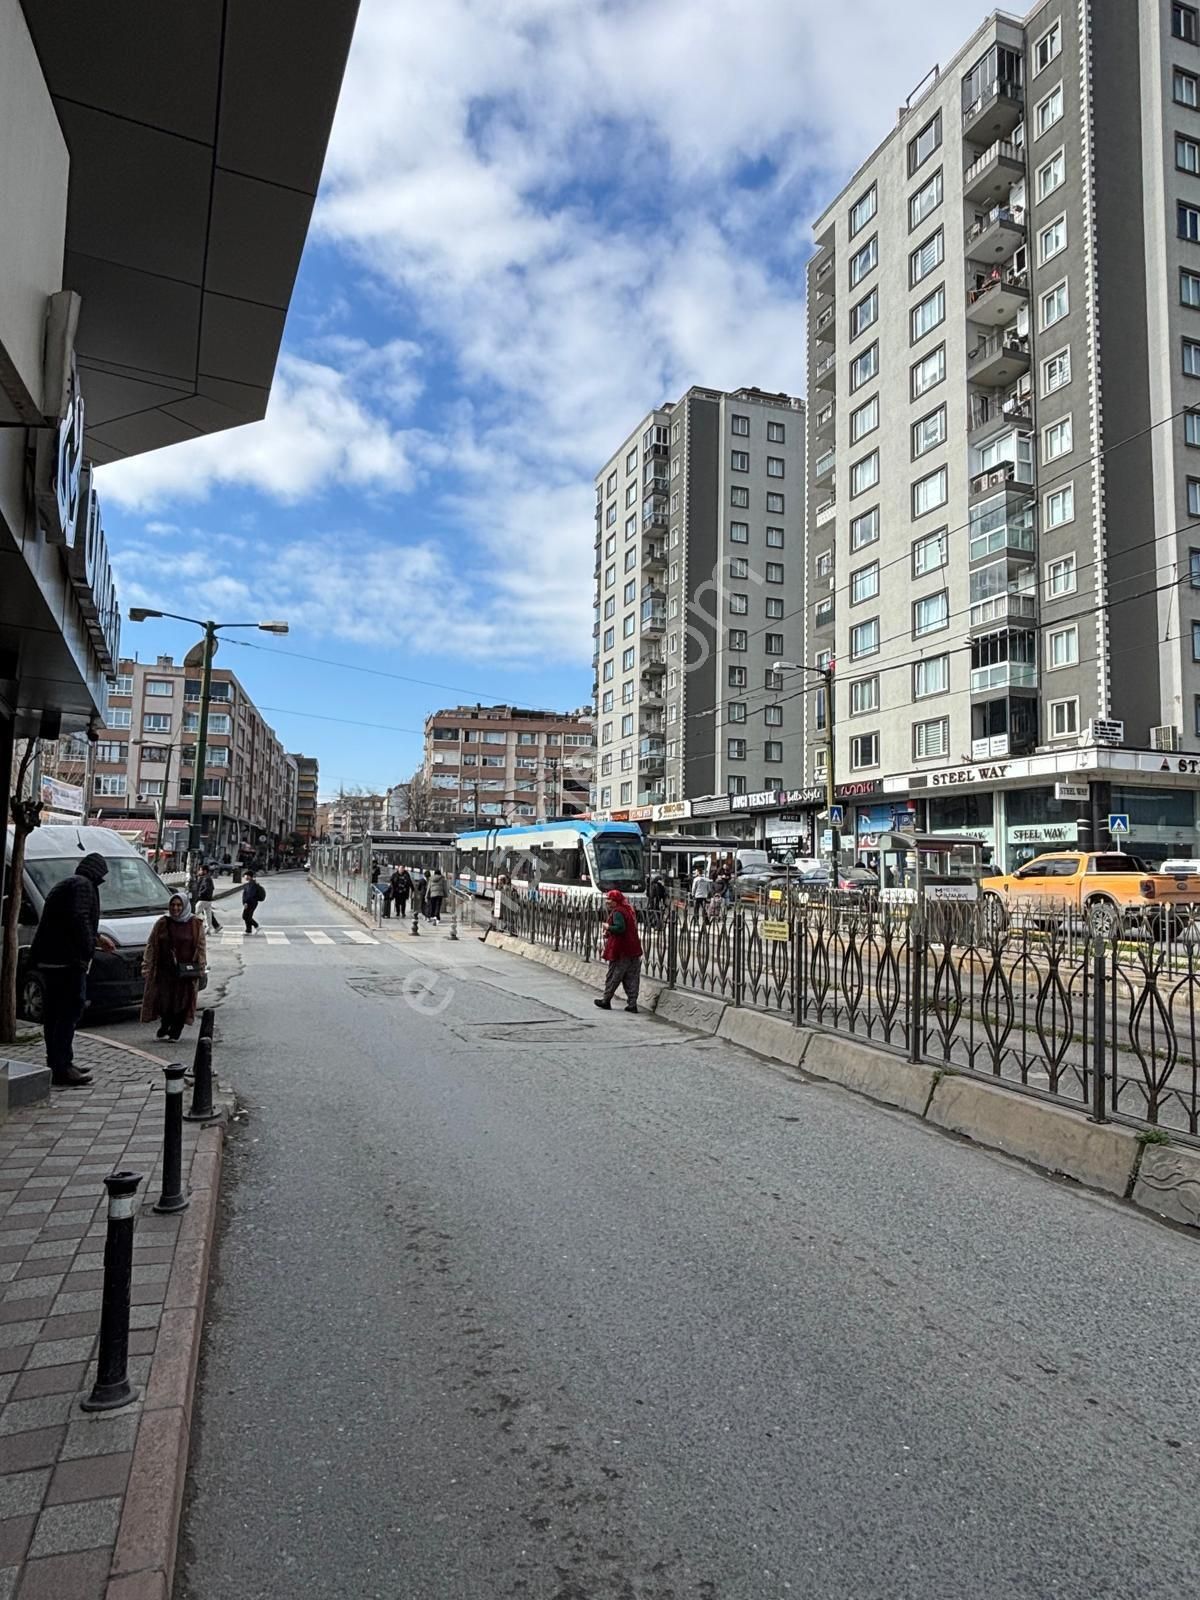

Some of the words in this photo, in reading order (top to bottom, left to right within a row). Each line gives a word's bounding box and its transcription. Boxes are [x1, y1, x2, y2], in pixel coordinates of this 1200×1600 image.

[932, 770, 975, 786] STEEL
[978, 765, 1009, 780] WAY
[802, 788, 821, 801] Style
[732, 795, 748, 809] AVCI
[1013, 829, 1041, 840] STEEL
[1043, 828, 1065, 839] WAY
